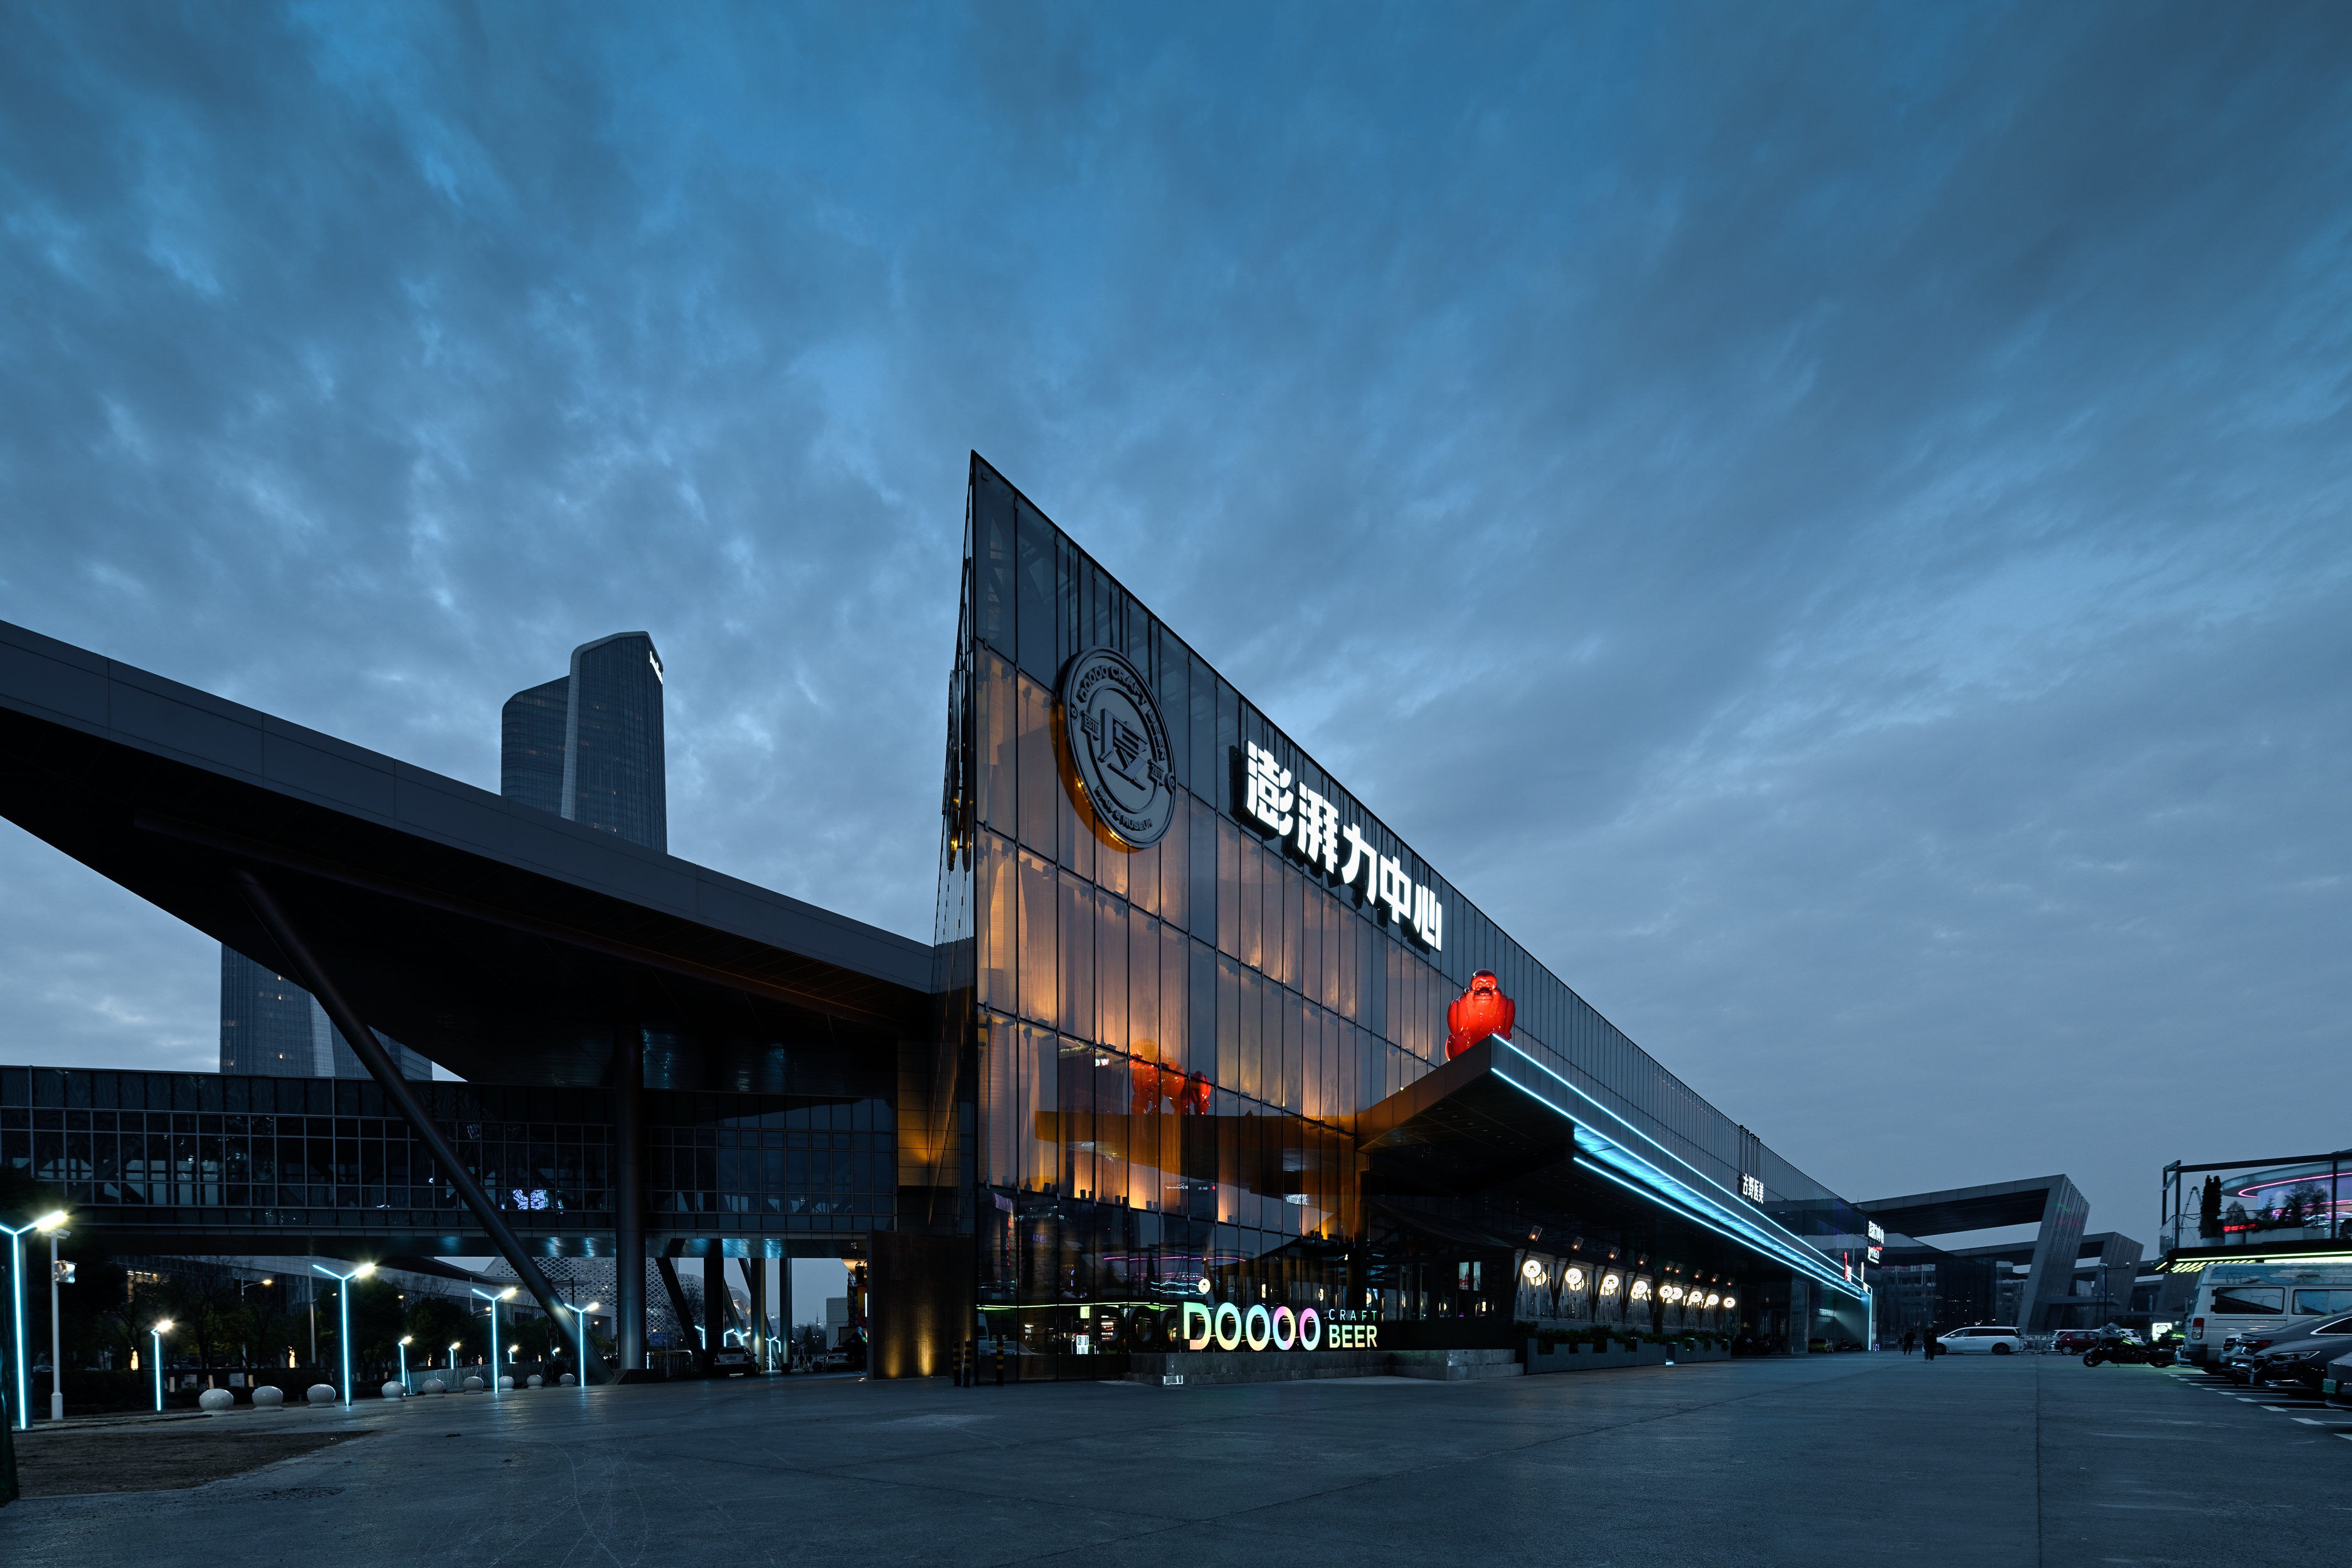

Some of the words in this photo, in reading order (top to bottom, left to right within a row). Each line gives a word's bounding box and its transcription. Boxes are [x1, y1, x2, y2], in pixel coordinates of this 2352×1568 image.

[1079, 664, 1109, 701] DOOOO
[1111, 665, 1148, 704] CRAFT
[1148, 708, 1167, 760] BEER
[1084, 716, 1099, 734] ESTD
[1097, 785, 1114, 813] BAR
[1122, 815, 1153, 830] MUSEUM
[1246, 740, 1442, 951] 澎湃力中心
[1183, 1301, 1321, 1351] DOOOO
[1328, 1308, 1378, 1321] CRAFT
[1328, 1324, 1378, 1348] BEER
